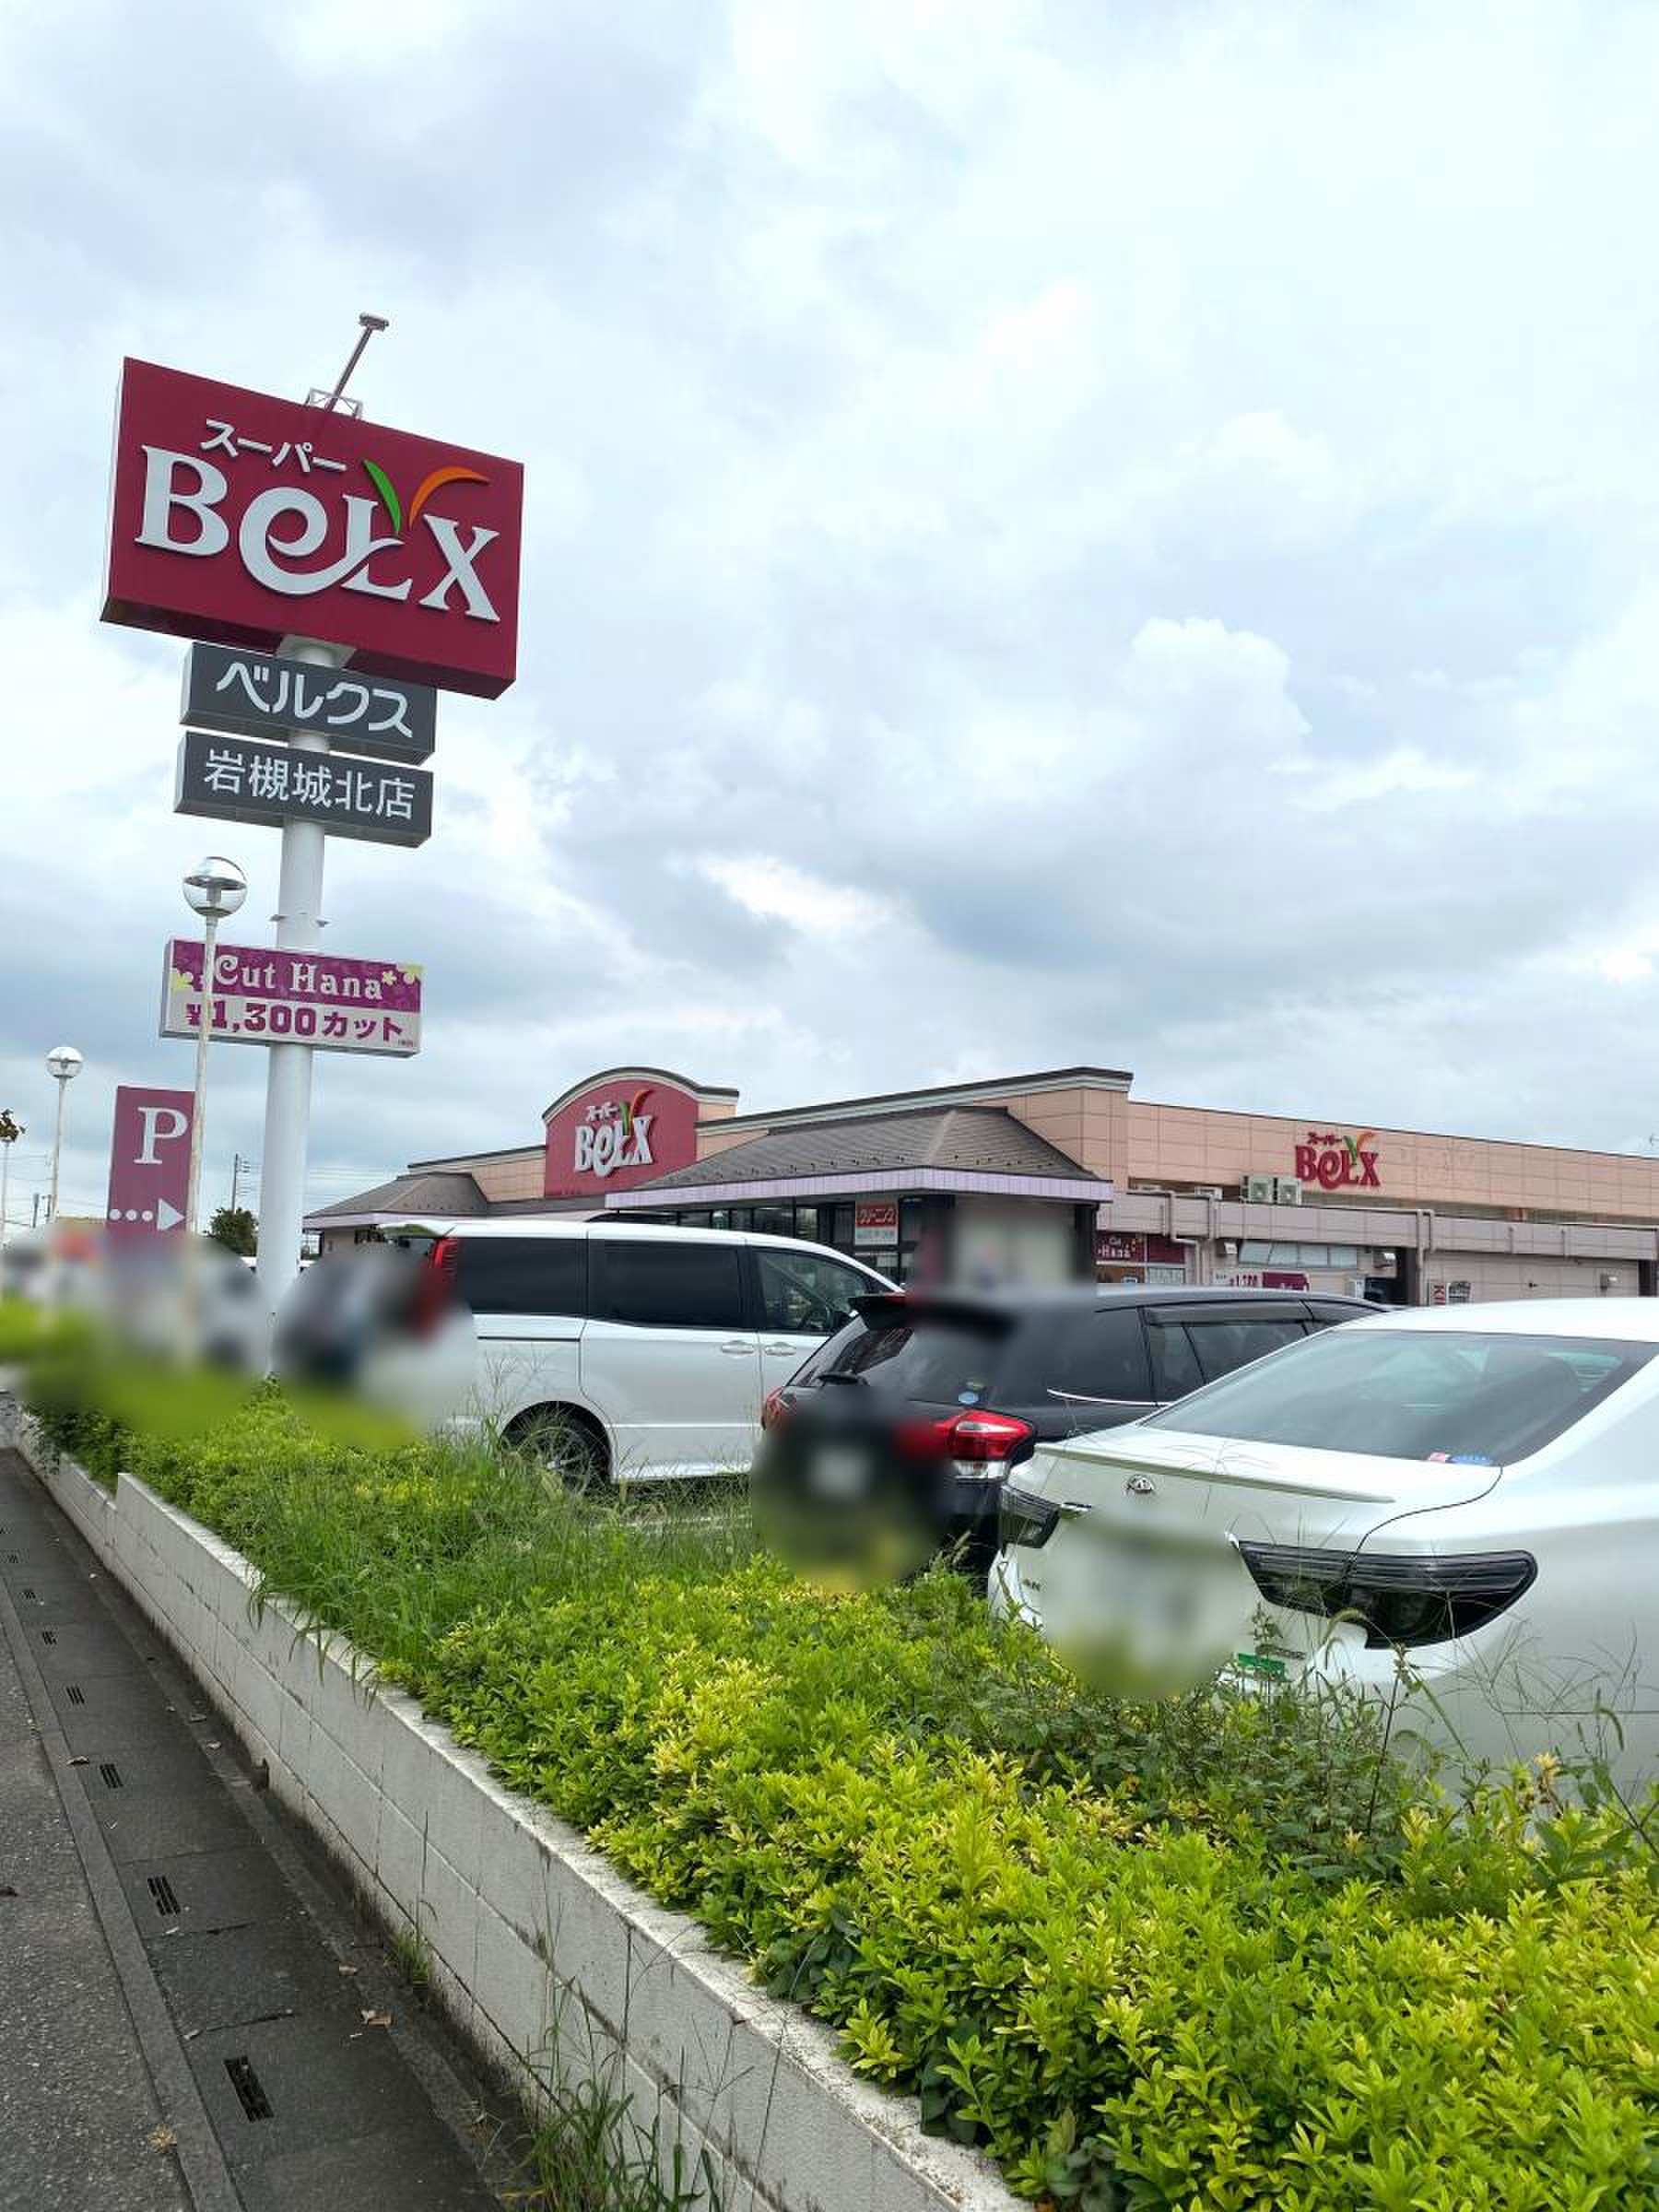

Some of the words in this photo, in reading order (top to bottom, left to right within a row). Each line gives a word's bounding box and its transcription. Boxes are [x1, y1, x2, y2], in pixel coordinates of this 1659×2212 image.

[200, 418, 347, 474] スーパー
[215, 661, 414, 738] ベルクス
[203, 747, 416, 820] 岩槻城北店
[213, 953, 276, 991] Cut
[289, 961, 383, 1001] Hana
[133, 1105, 189, 1165] P
